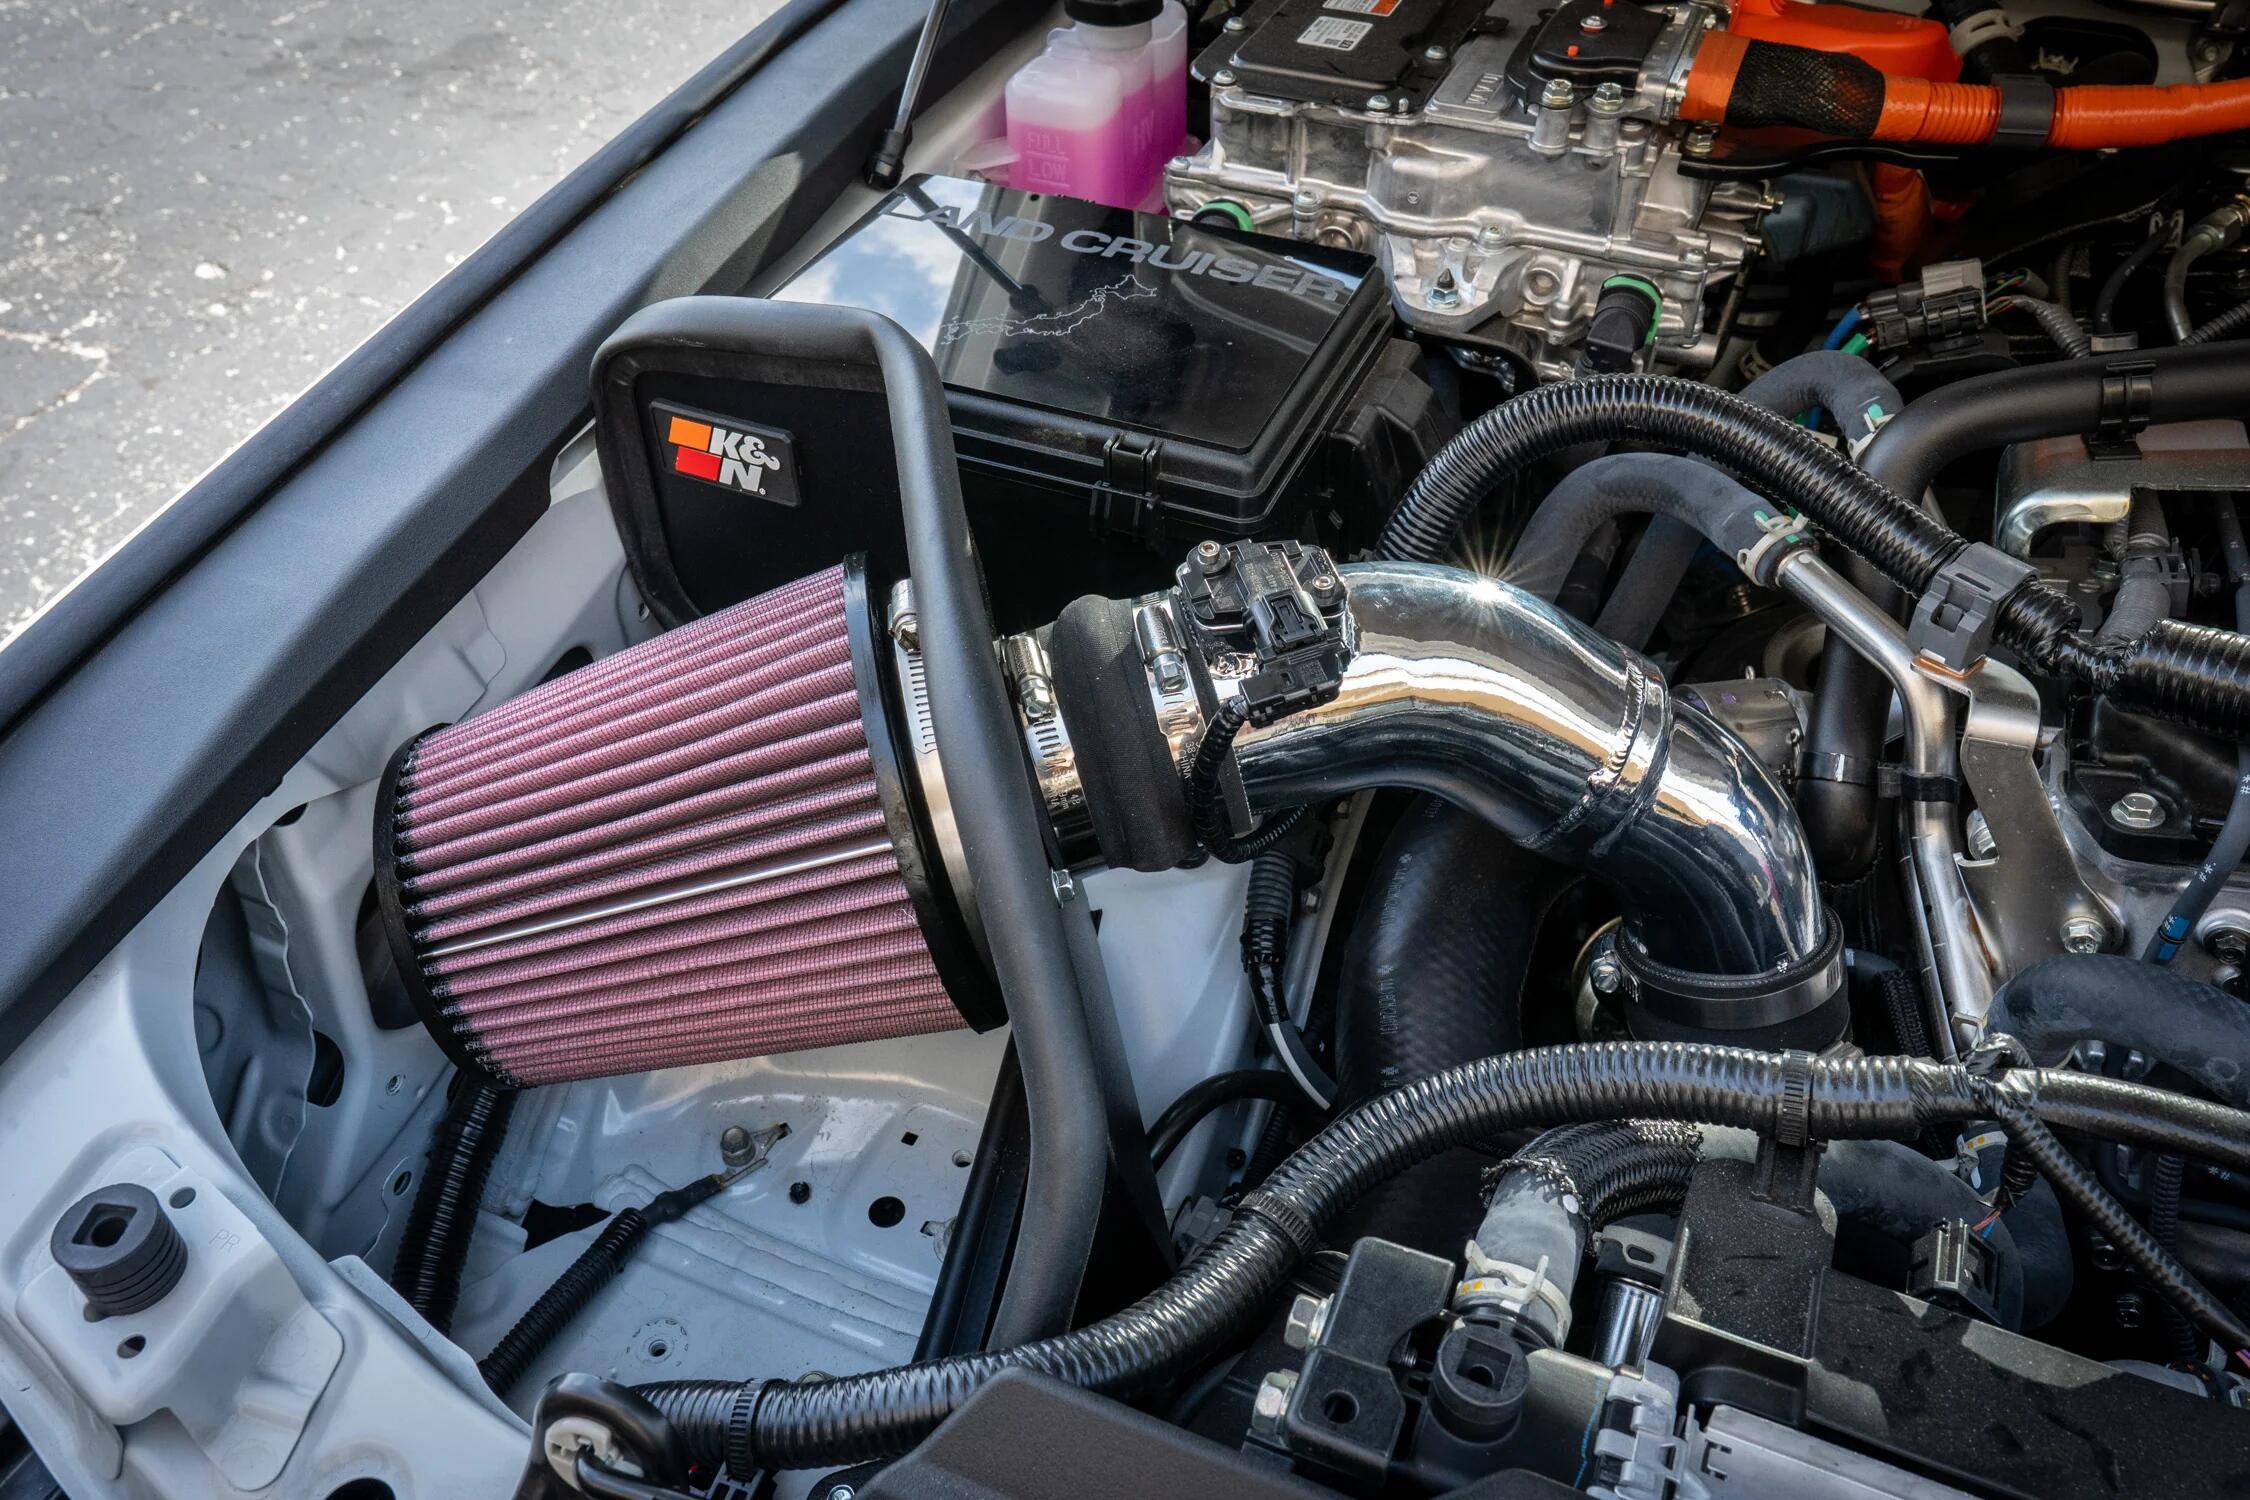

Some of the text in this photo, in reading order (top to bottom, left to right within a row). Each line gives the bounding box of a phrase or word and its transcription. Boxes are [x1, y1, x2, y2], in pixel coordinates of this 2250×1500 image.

[1026, 130, 1066, 155] FULL
[1027, 158, 1067, 181] LOW
[878, 196, 1348, 302] LAND CRUISER
